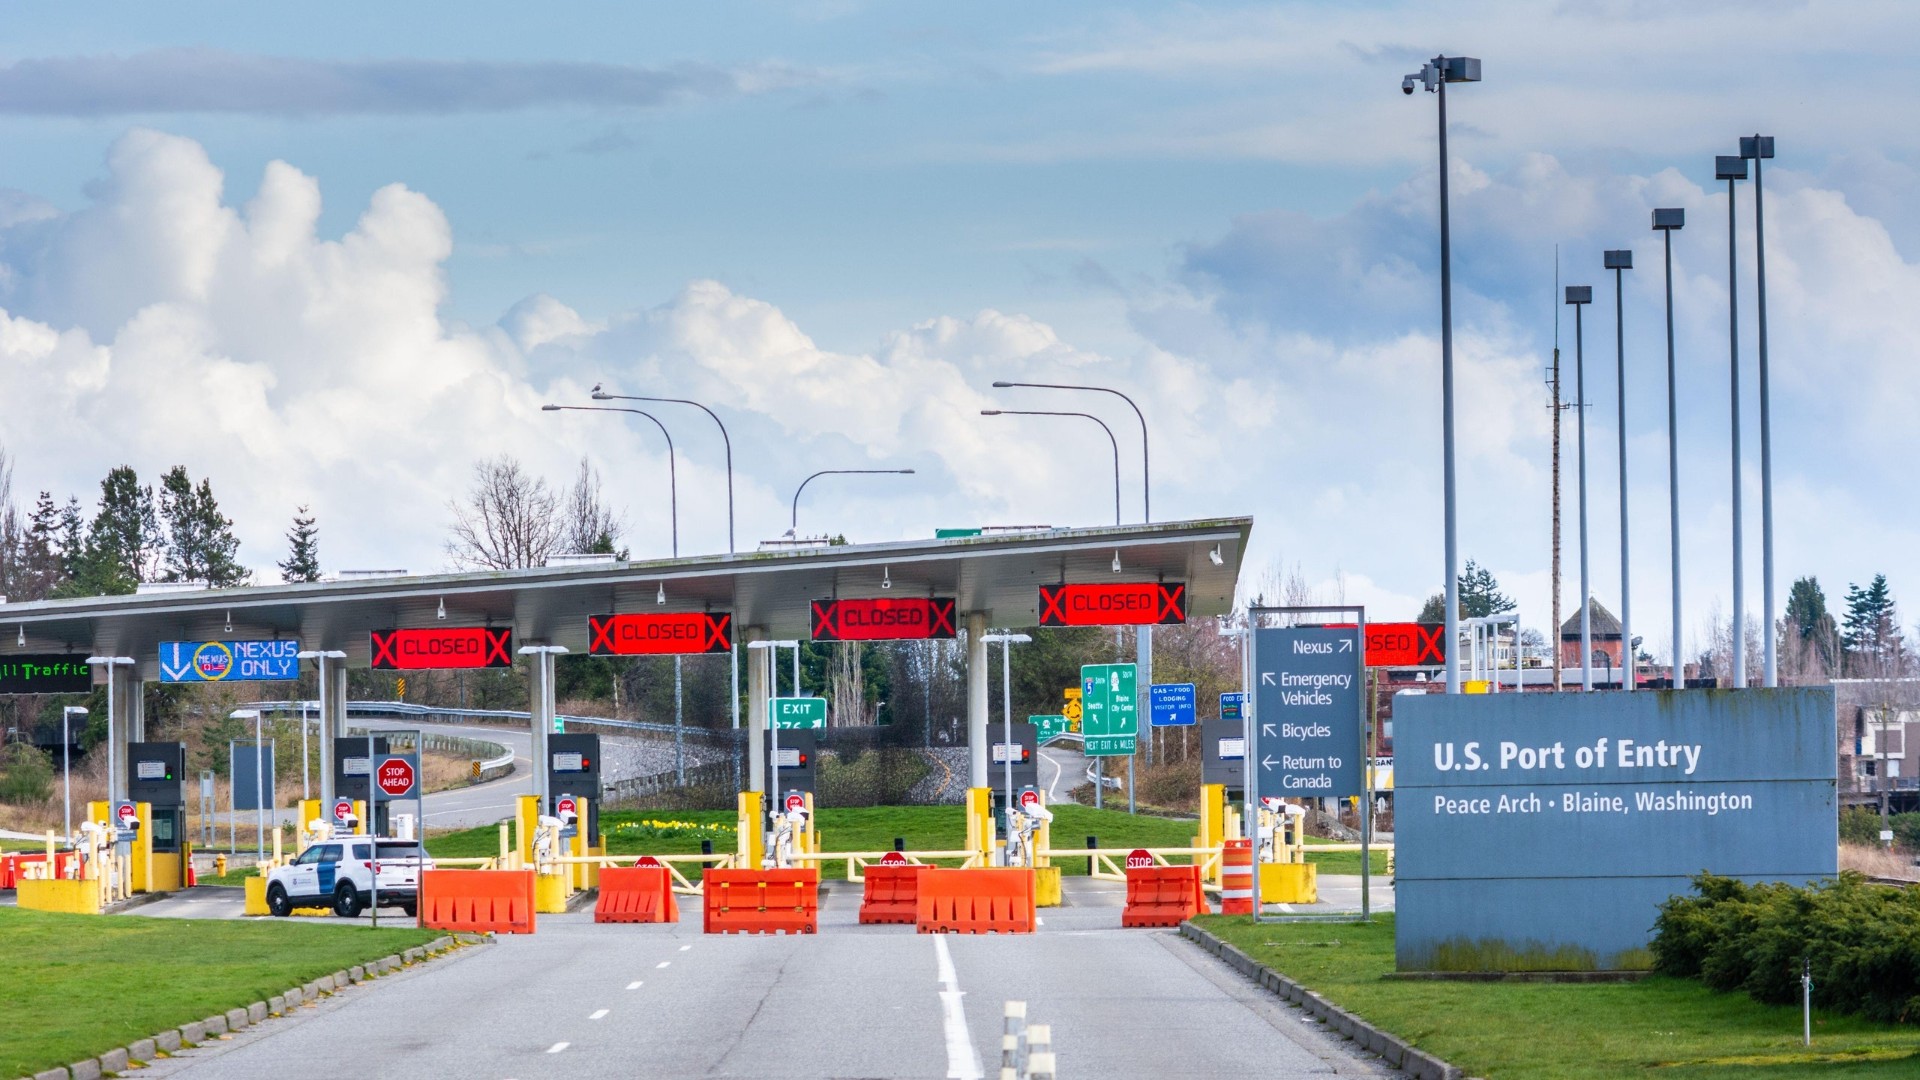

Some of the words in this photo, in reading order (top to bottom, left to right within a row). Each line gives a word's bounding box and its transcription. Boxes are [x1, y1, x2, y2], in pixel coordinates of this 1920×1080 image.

[1073, 593, 1151, 611] CLOSED
[844, 608, 922, 626] CLOSED
[622, 623, 698, 640] CLOSED
[234, 641, 297, 658] NEXUS
[403, 638, 479, 655] CLOSED
[1293, 639, 1333, 654] Nexus
[0, 664, 17, 679] ll
[21, 663, 88, 679] Traffic
[241, 659, 291, 676] ONLY
[1281, 671, 1352, 690] Emergency
[1281, 689, 1333, 705] Vehicles
[783, 703, 811, 714] EXIT
[1282, 722, 1331, 741] Bicycles
[1086, 741, 1099, 750] NEXT
[1101, 740, 1111, 750] EXIT
[1120, 739, 1135, 750] MILES
[1282, 755, 1325, 770] Return
[1328, 755, 1342, 769] to
[1434, 741, 1489, 771] U.S.
[1500, 741, 1565, 770] Port
[1575, 737, 1608, 768] of
[1618, 739, 1701, 774] Entry
[386, 767, 405, 776] STOP
[382, 777, 409, 787] AHEAD
[1282, 773, 1332, 788] Canada
[1435, 795, 1490, 814] Peace
[1497, 792, 1541, 813] Arch
[1563, 792, 1629, 815] Blaine,
[1635, 790, 1752, 815] Washington
[1128, 857, 1152, 868] STOP
